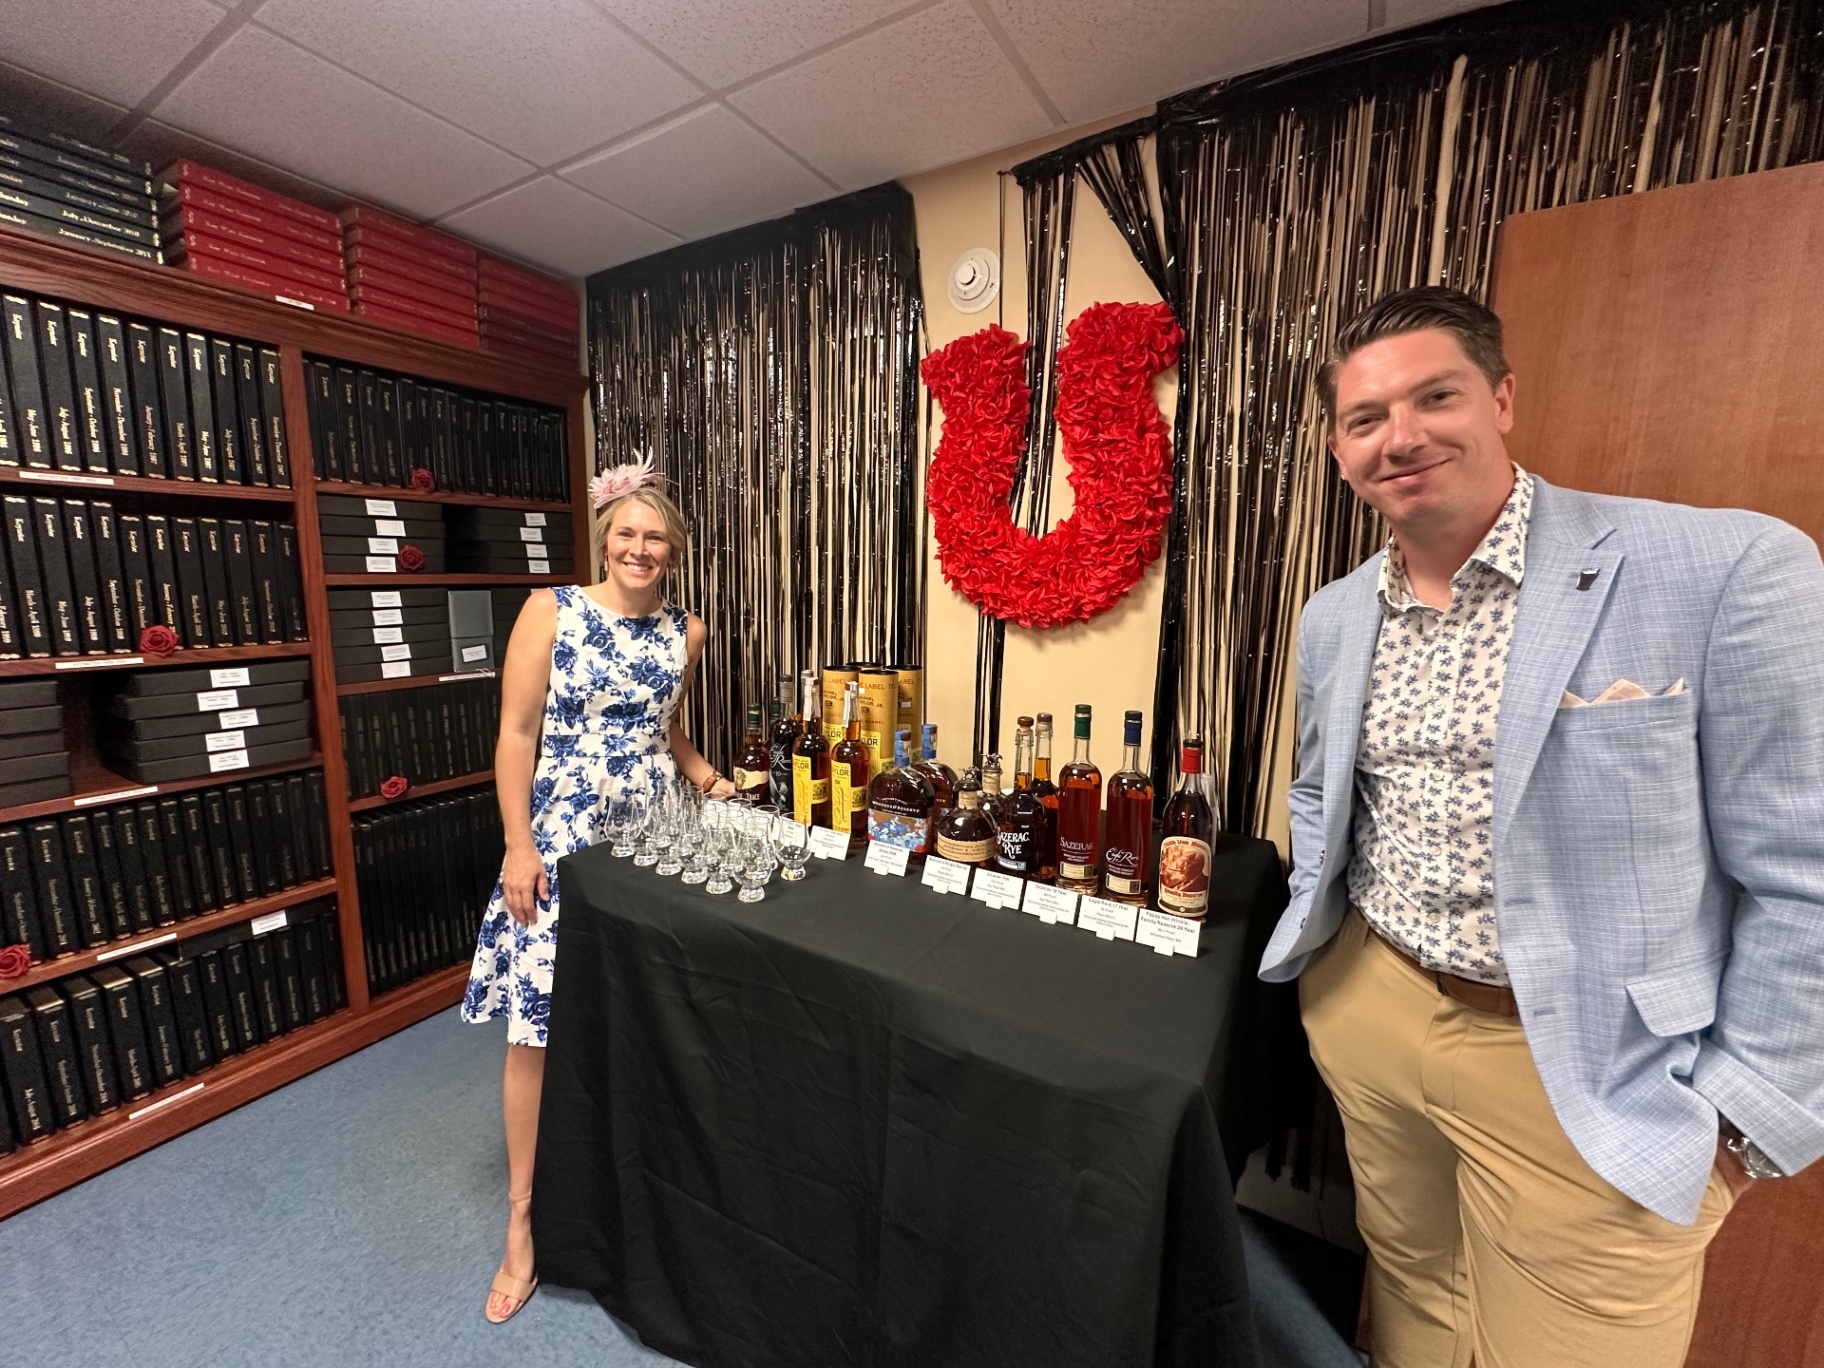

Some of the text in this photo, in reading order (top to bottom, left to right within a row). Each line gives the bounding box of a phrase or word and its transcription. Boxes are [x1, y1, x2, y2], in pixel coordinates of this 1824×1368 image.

[62, 210, 78, 221] July
[59, 228, 91, 242] January
[47, 320, 57, 346] Keynoter
[78, 332, 87, 356] Keynoter
[108, 337, 117, 362] Keynoter
[12, 313, 23, 340] Keynoter
[27, 409, 36, 421] May
[168, 345, 176, 368] Keynoter
[138, 340, 146, 363] Keynoter
[145, 406, 153, 424] January
[84, 387, 95, 414] September
[114, 388, 123, 413] November
[193, 348, 202, 371] Keynoter
[201, 431, 209, 442] May
[59, 407, 69, 418] July
[61, 420, 70, 439] August
[89, 418, 98, 438] October
[117, 416, 127, 441] December
[177, 423, 185, 438] March
[251, 417, 259, 441] September
[178, 442, 186, 454] April
[15, 518, 24, 542] Keynoter
[45, 514, 54, 537] Keynoter
[73, 516, 82, 539] Keynoter
[101, 516, 121, 626] Keynoter September October
[129, 531, 137, 552] Keynoter
[135, 579, 144, 603] November
[156, 529, 174, 624] Keynoter January February
[25, 590, 36, 606] March
[58, 601, 68, 612] May
[85, 596, 93, 606] July
[29, 610, 39, 624] April
[60, 616, 69, 628] June
[86, 611, 95, 627] August
[997, 827, 1030, 844] SAZERAC
[1002, 841, 1022, 859] RYE
[1140, 917, 1156, 925] Family
[1158, 920, 1177, 929] Reserve
[1146, 911, 1160, 920] Pappy
